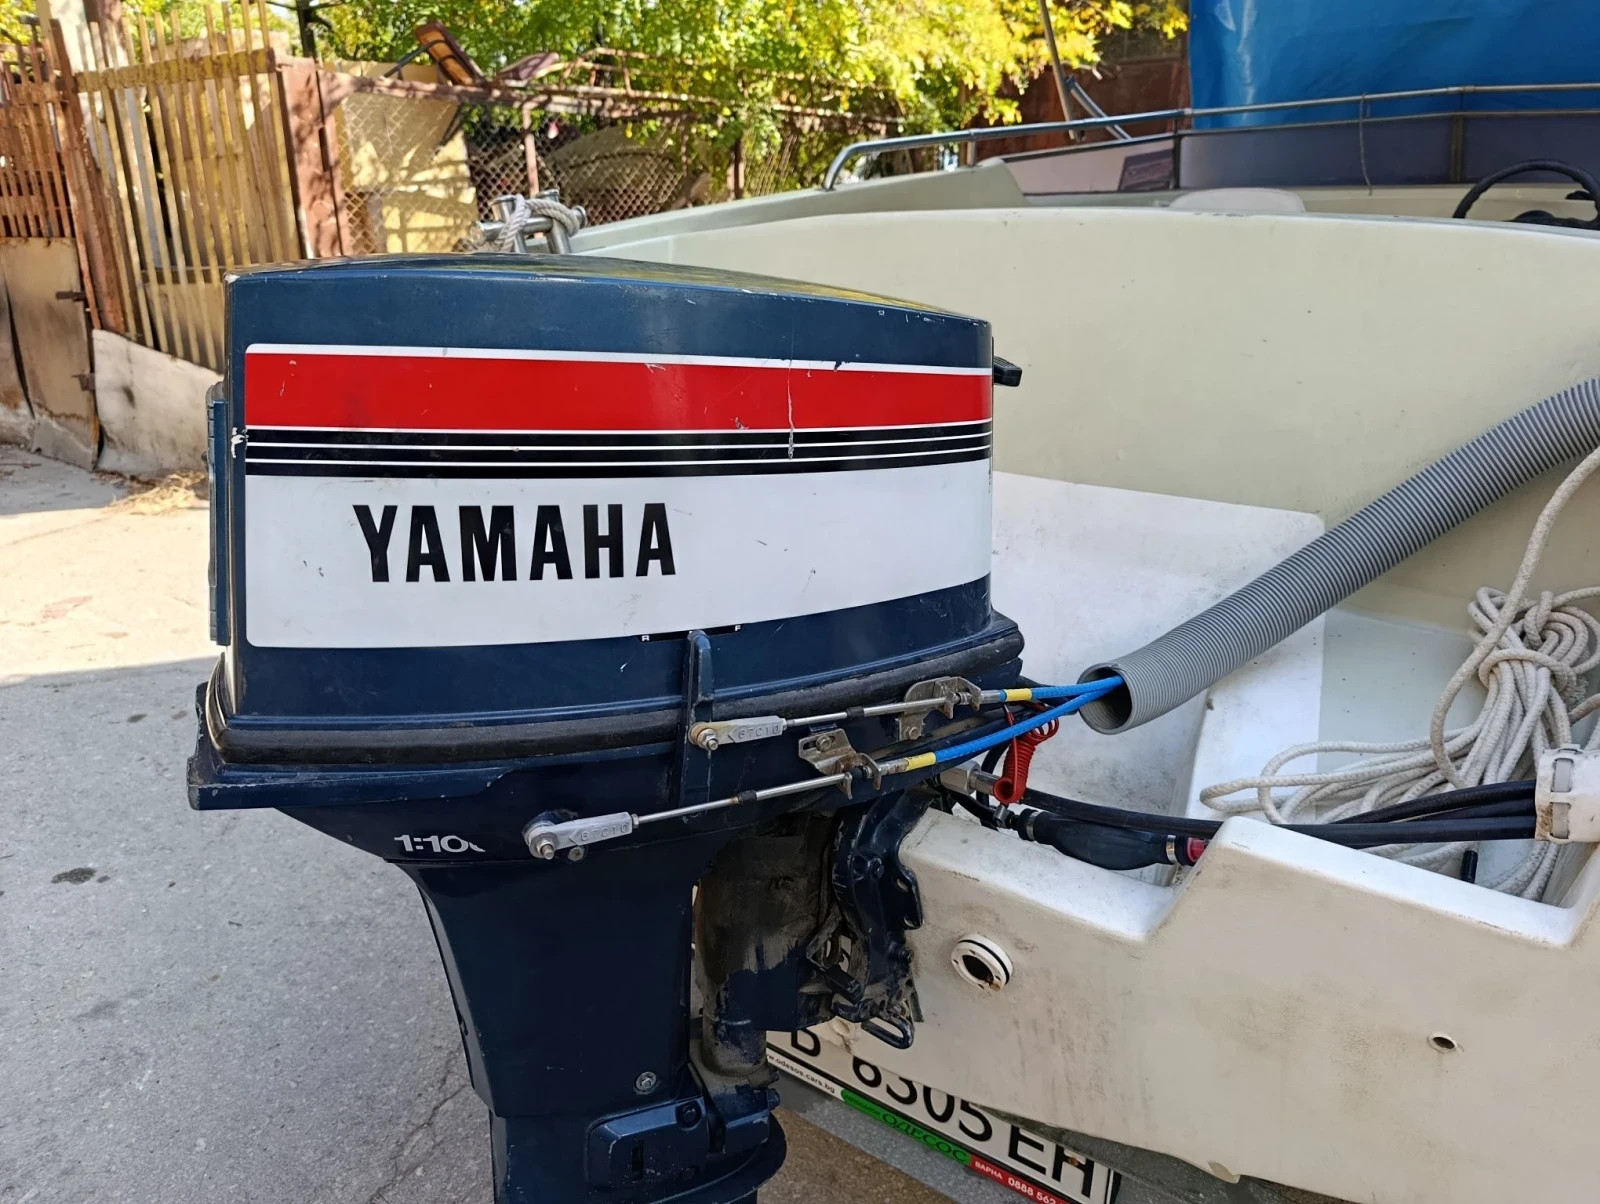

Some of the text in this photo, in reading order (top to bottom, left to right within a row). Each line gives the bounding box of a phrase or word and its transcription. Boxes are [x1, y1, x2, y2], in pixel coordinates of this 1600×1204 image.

[352, 503, 676, 583] YAMAHA
[641, 624, 742, 642] R F
[883, 1113, 967, 1162] ОДЕСОС
[975, 1161, 1003, 1180] ВАРНА
[1008, 1177, 1034, 1196] 0888
